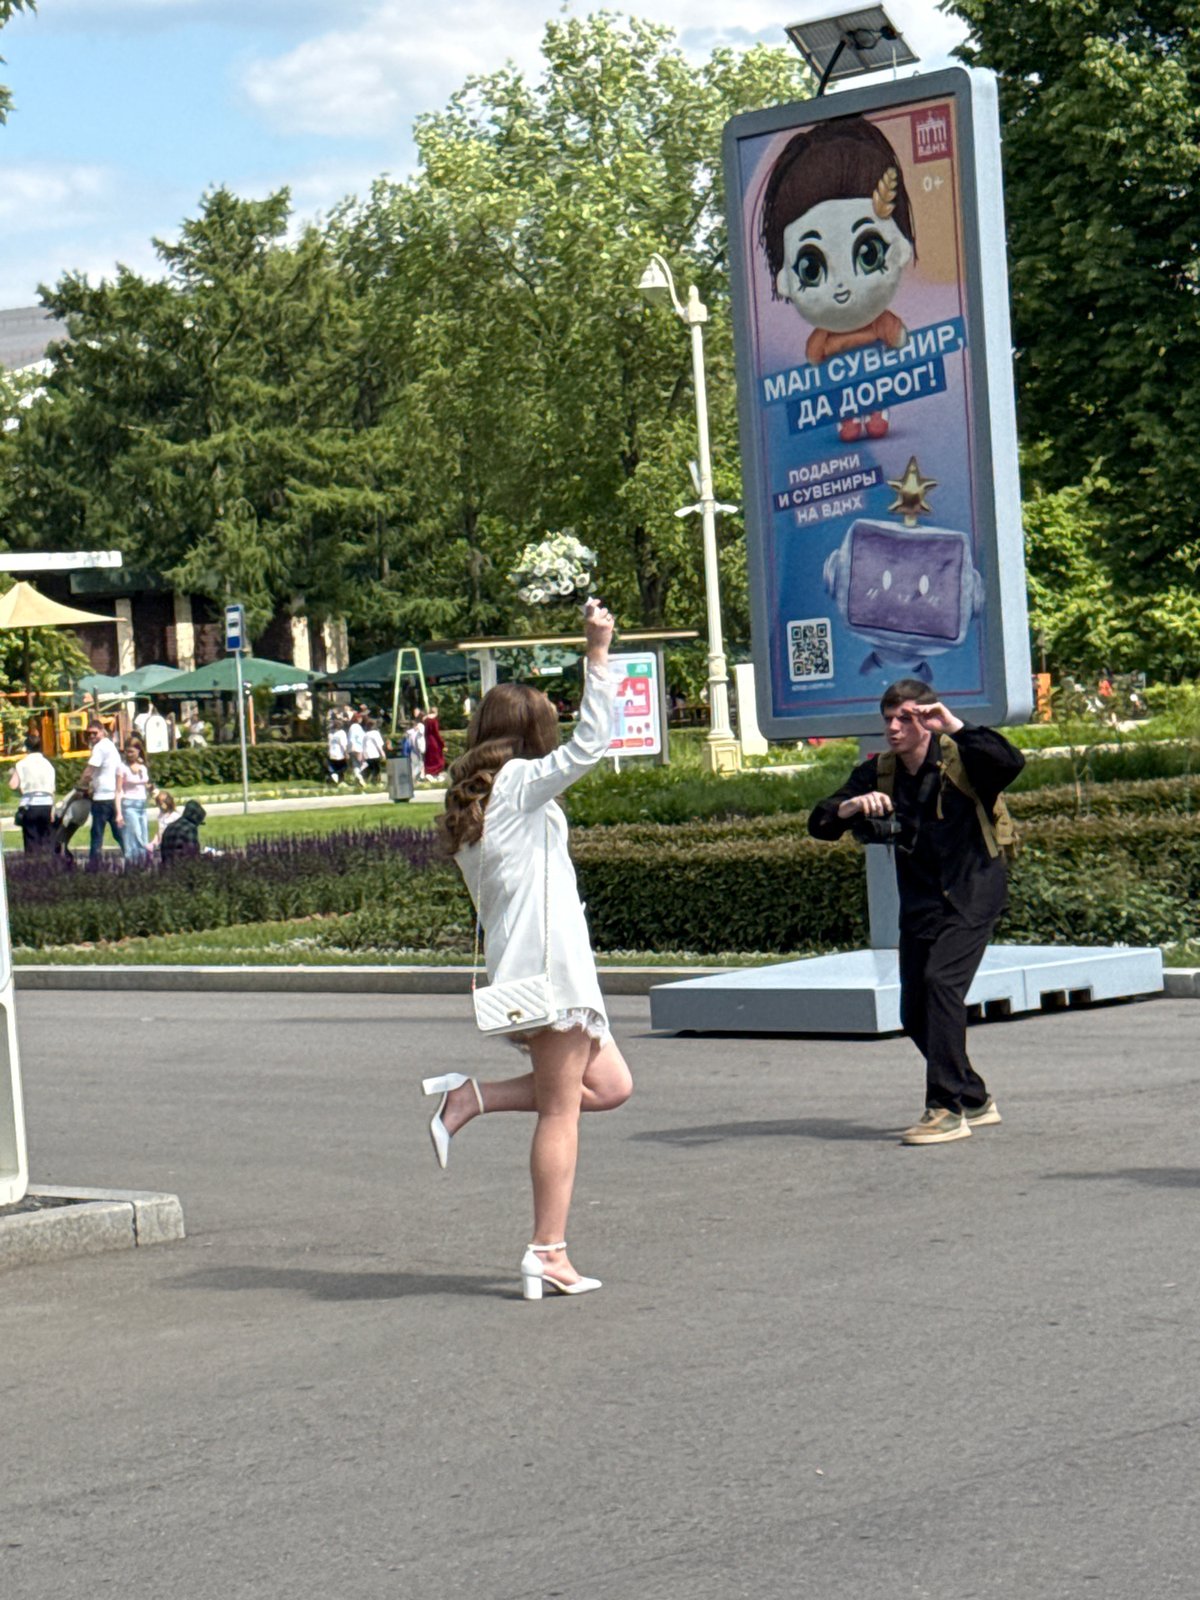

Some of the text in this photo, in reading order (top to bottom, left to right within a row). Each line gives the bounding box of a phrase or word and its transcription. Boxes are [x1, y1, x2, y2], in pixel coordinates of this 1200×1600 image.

[924, 175, 944, 192] 0+
[764, 367, 821, 401] МАЛ
[798, 362, 936, 429] ДА ДОРОГ!
[789, 454, 860, 485] ПОДАРКИ
[779, 470, 876, 508] И СУВЕНИРЫ
[797, 496, 863, 523] НА ВДНХ
